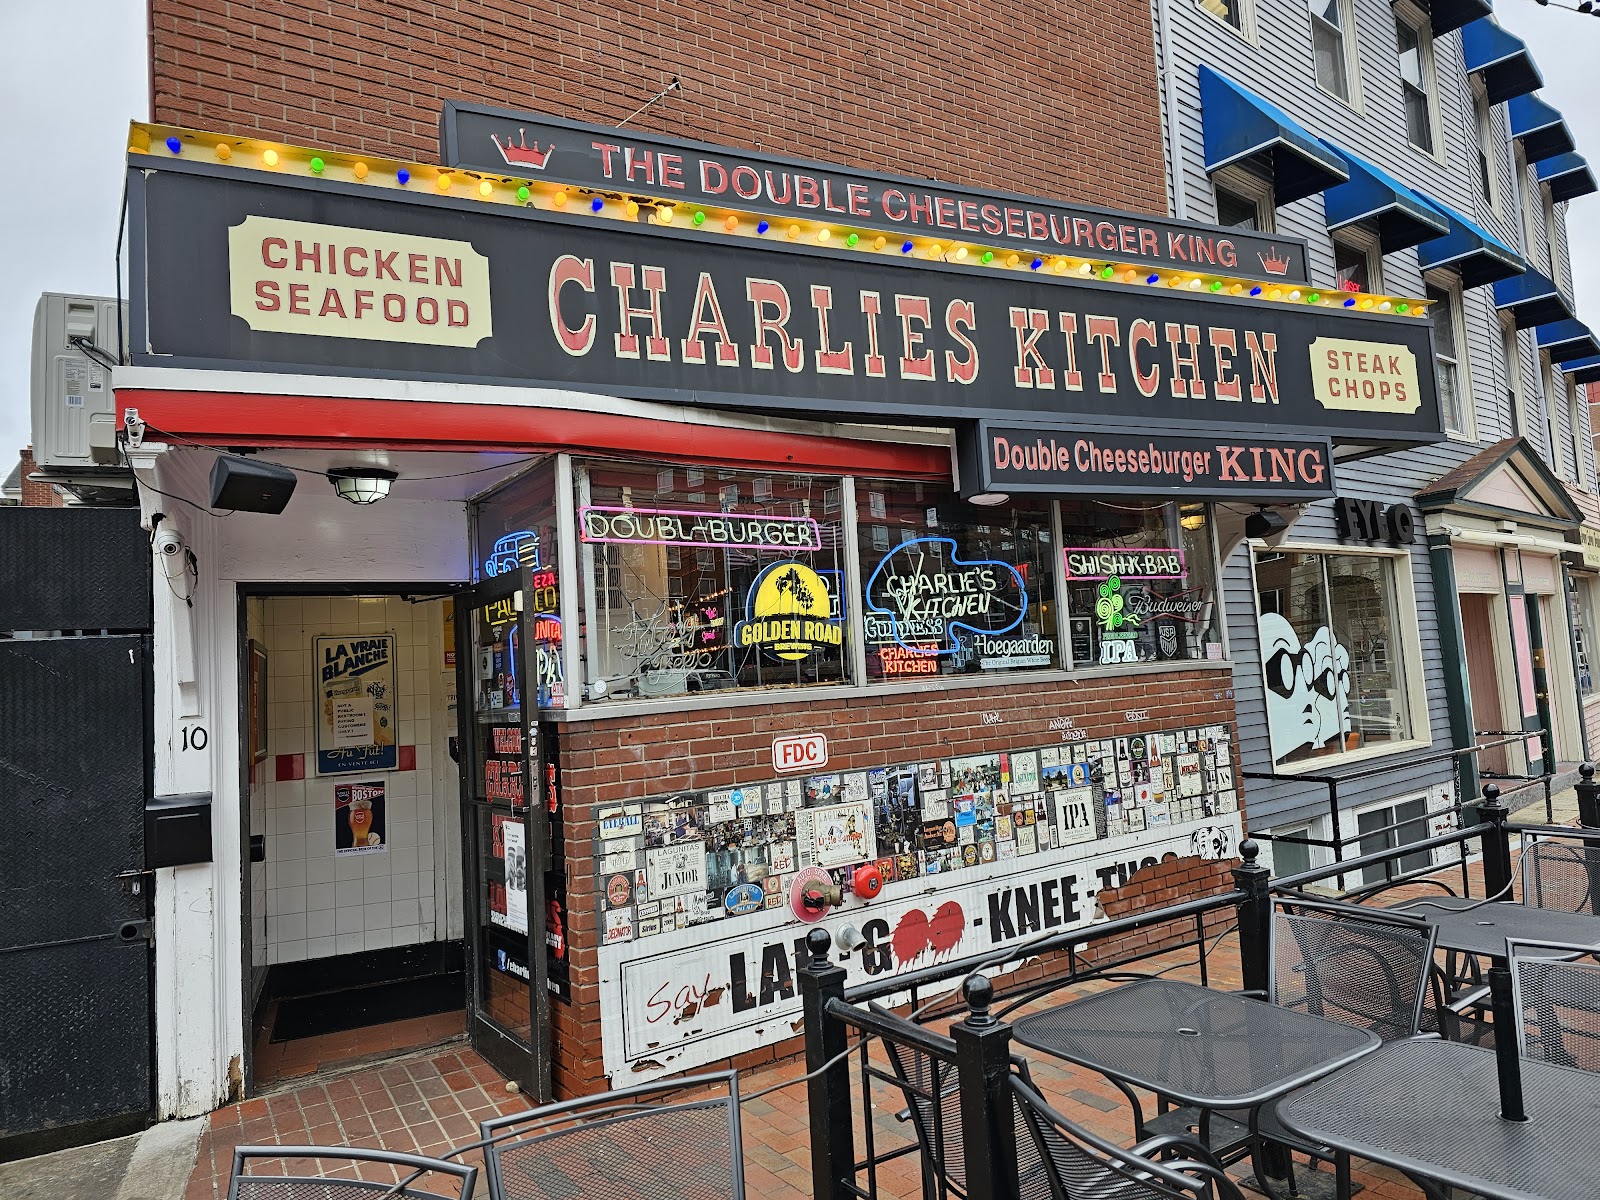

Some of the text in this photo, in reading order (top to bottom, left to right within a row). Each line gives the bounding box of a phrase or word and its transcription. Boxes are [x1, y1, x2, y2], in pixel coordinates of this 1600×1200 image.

[591, 140, 1238, 269] THE DOUBLE CHEESEBURGER KING
[261, 236, 464, 288] CHICKEN
[254, 279, 470, 328] SEAFOOD
[547, 253, 1281, 406] CHARLIES KITCHEN
[1326, 349, 1402, 377] STEAK
[1327, 376, 1407, 403] CHOPS
[993, 436, 1326, 484] Double Cheeseburger KING
[886, 567, 997, 597] CHARLIE'S
[904, 593, 991, 622] KITCHEN
[1128, 596, 1204, 615] Budweiser
[741, 620, 801, 646] GOLDEN
[804, 620, 843, 646] ROAD
[974, 633, 1054, 658] Hoegaarden
[325, 638, 388, 664] LA VRAIE
[774, 643, 812, 651] BREWING
[1100, 640, 1139, 665] IPA
[321, 649, 389, 683] BLANCHE
[181, 725, 208, 752] 10
[781, 743, 818, 764] FDC
[351, 790, 384, 802] BOSTON
[1062, 802, 1090, 831] IPA
[657, 843, 700, 857] LAGUNITAS
[774, 857, 791, 870] RED
[661, 869, 699, 891] JUNIOR
[646, 973, 711, 1024] Say
